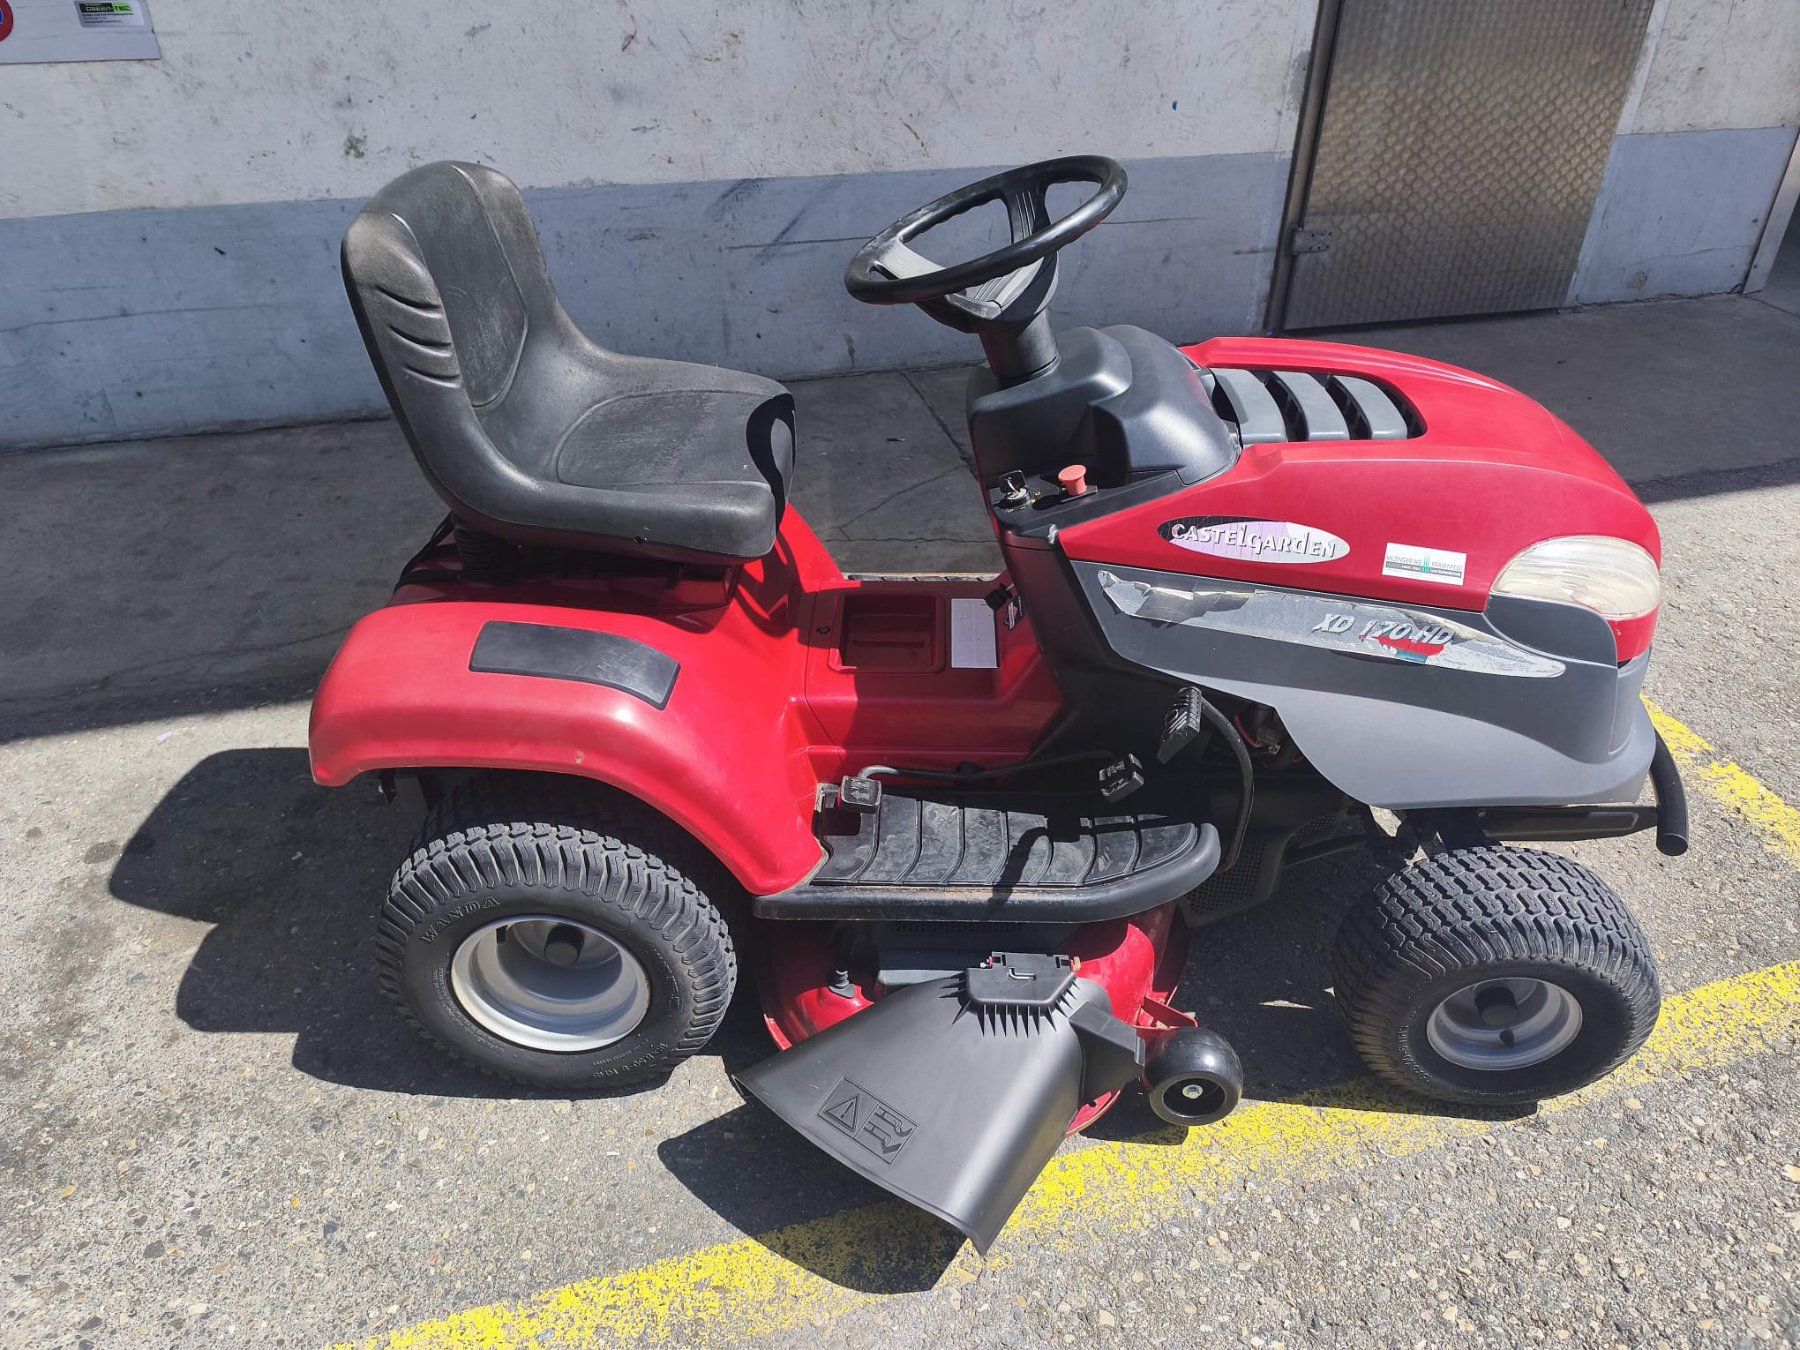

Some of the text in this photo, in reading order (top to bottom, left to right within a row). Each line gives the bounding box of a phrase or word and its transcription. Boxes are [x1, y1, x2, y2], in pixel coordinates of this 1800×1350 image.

[1311, 613, 1456, 646] XD 170 HD
[420, 895, 501, 943] WANDA
